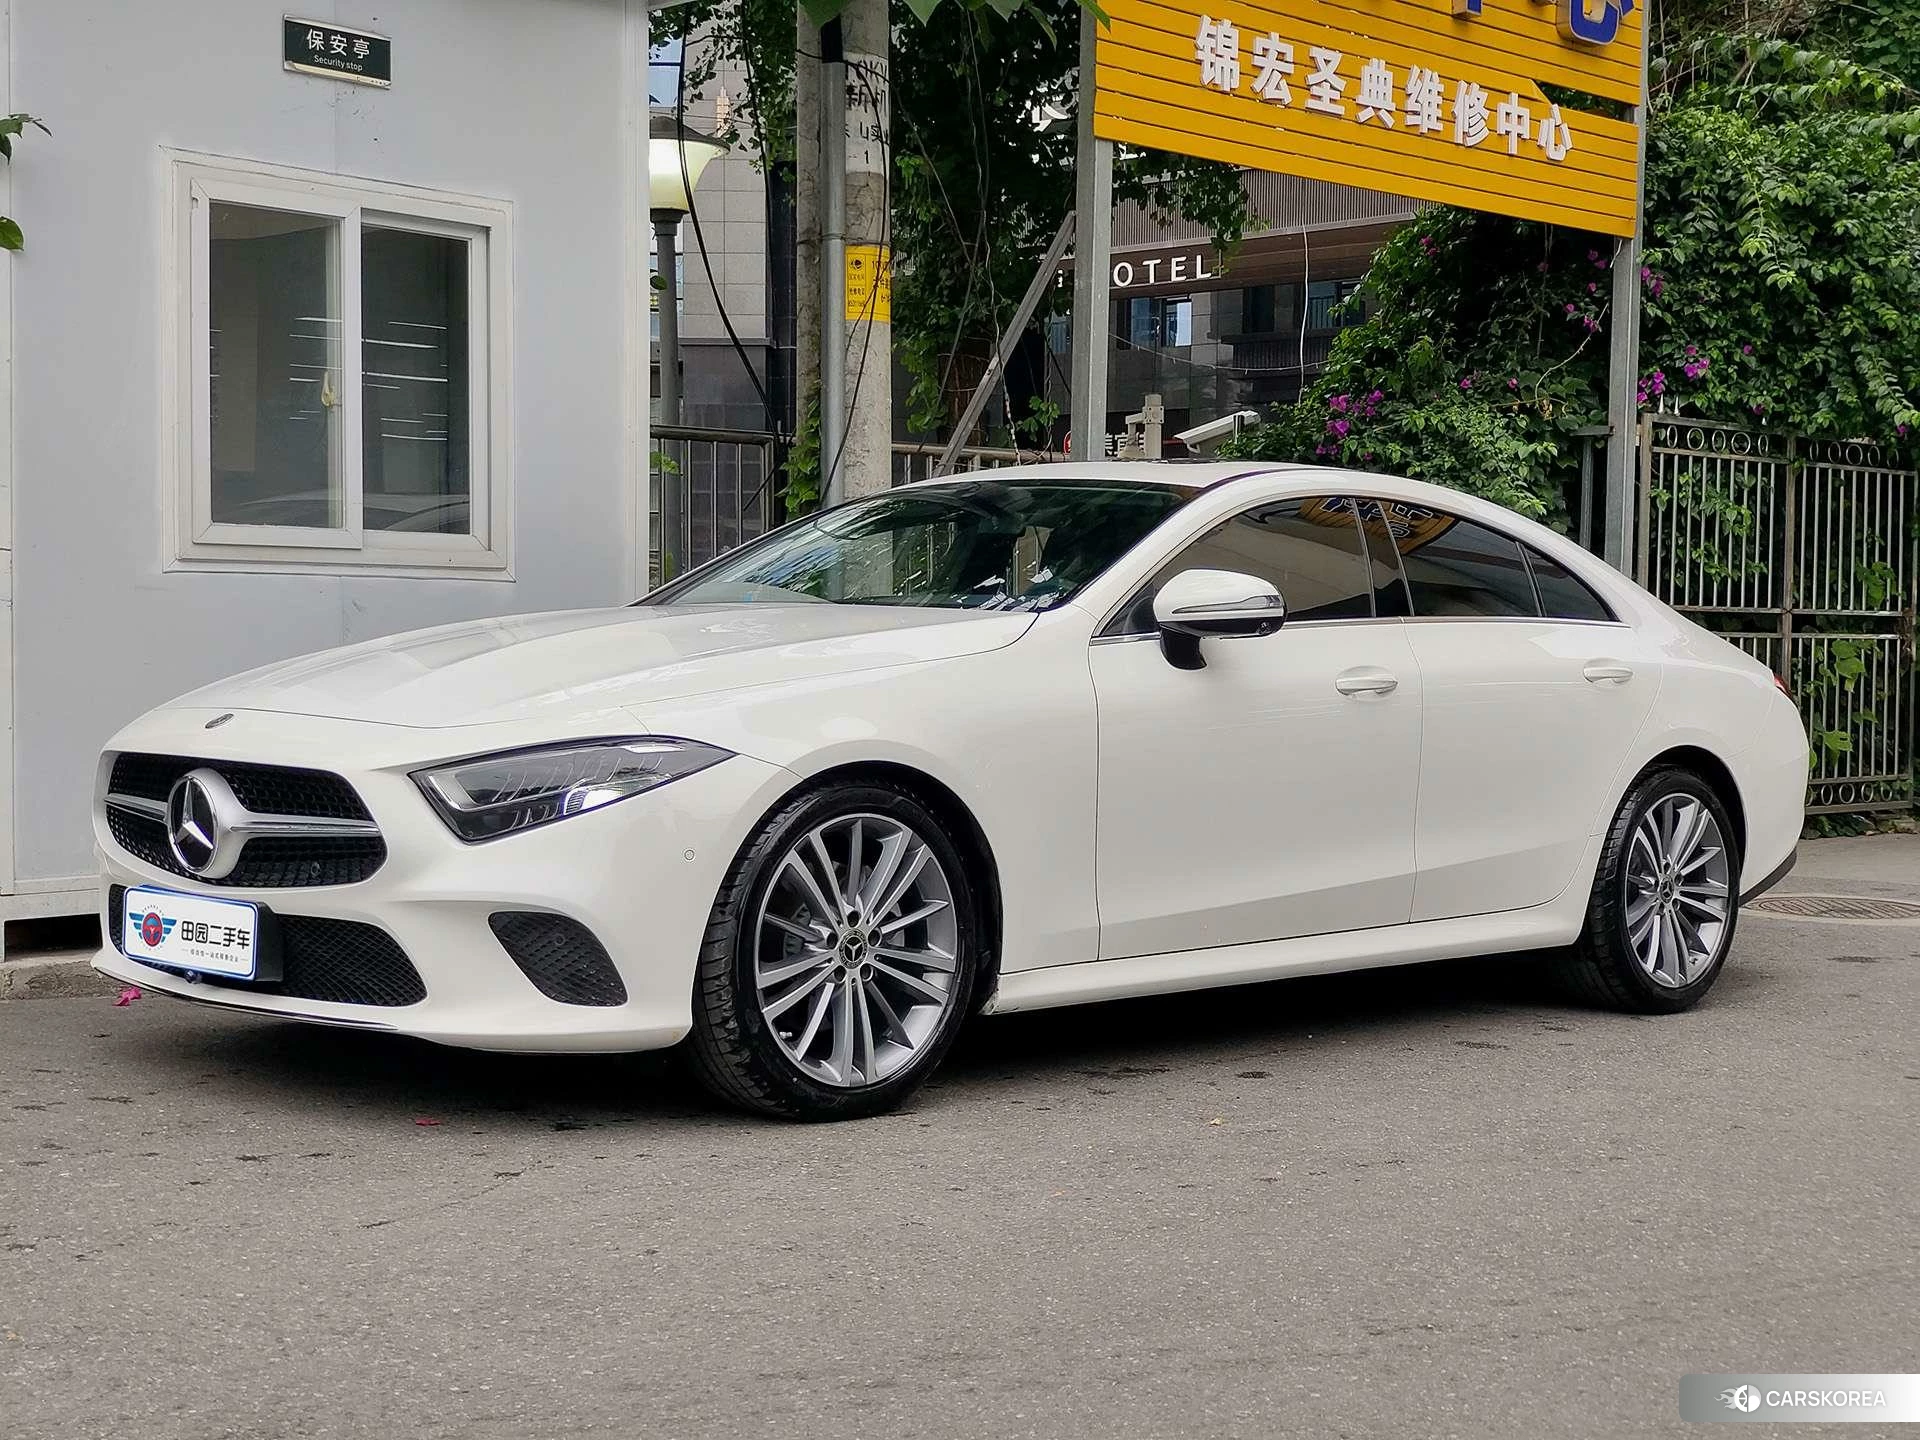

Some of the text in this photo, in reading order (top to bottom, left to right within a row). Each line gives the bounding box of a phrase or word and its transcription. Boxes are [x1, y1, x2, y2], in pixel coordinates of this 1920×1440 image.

[306, 28, 370, 59] 保安亭
[314, 54, 363, 72] Security stop
[1194, 14, 1573, 162] 锦宏圣典维修中心
[1112, 254, 1212, 287] OTEL
[181, 920, 251, 950] 田园二手车
